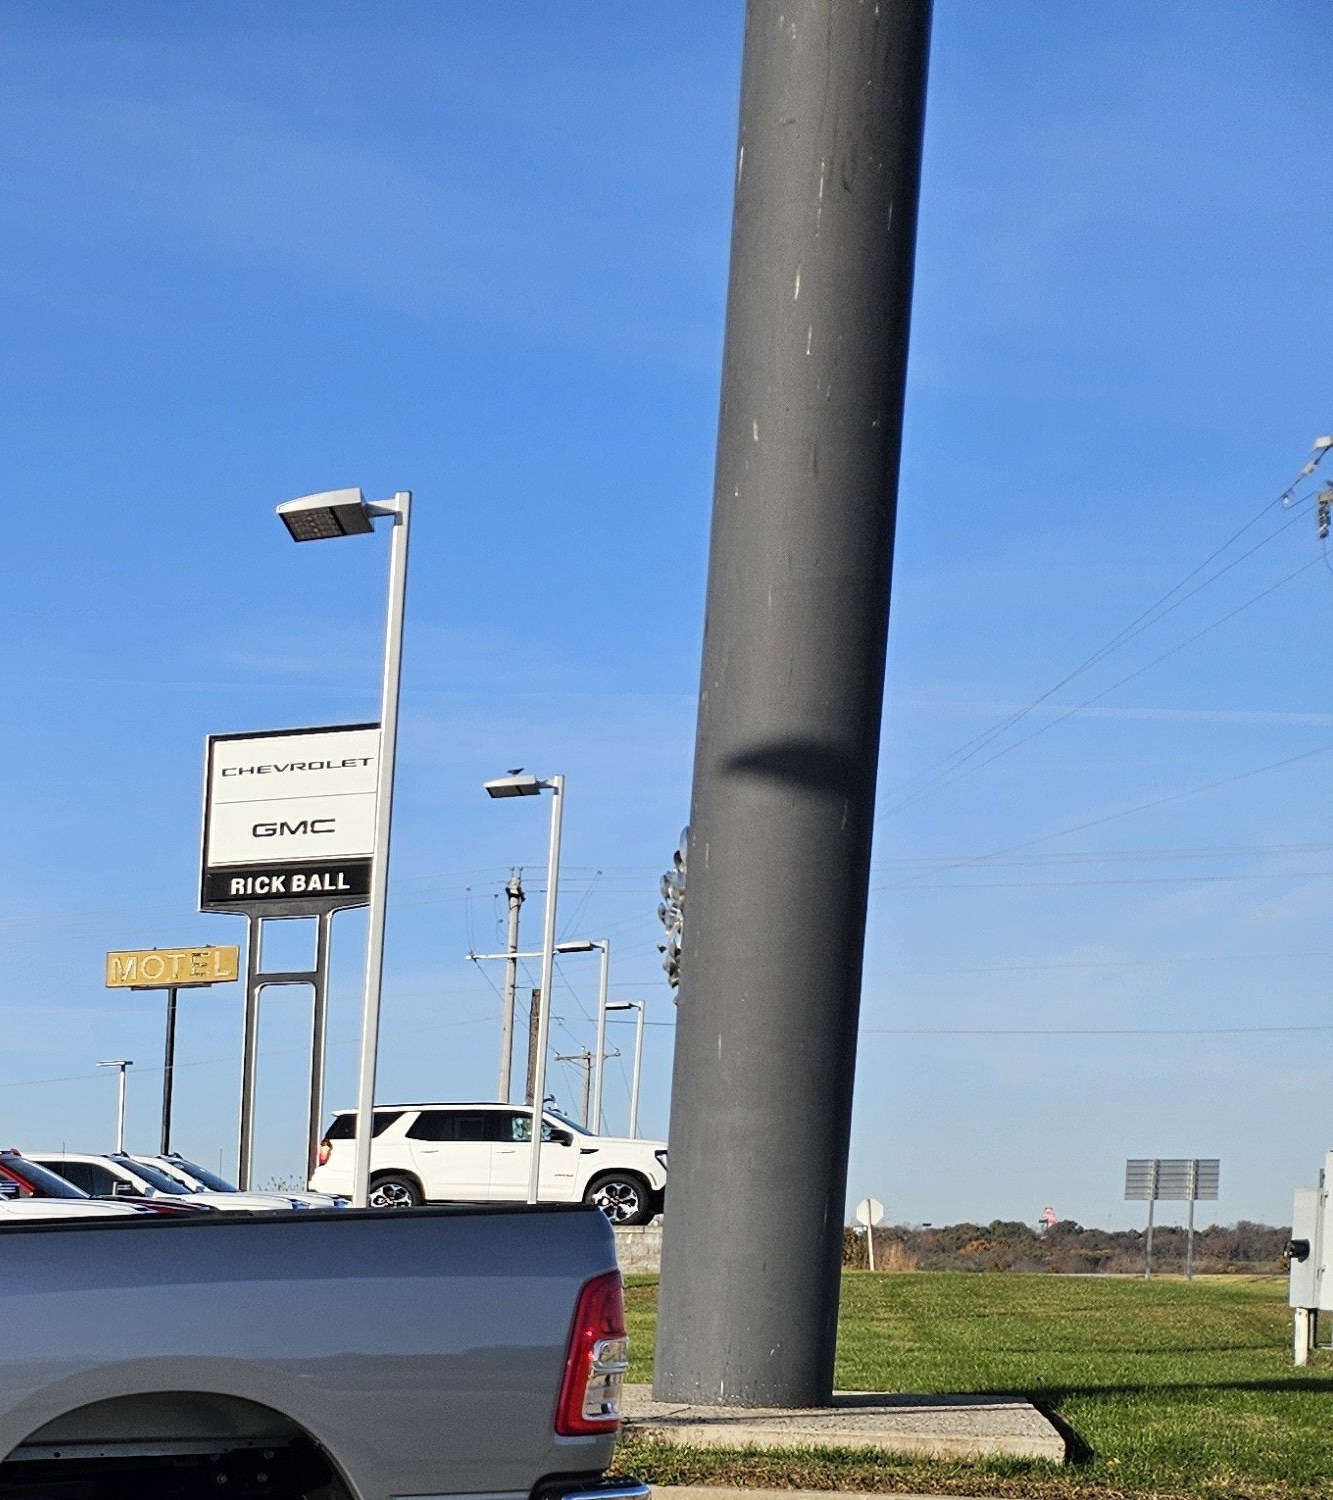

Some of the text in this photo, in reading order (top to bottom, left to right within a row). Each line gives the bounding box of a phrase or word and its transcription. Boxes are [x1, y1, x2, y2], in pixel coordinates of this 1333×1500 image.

[221, 757, 374, 777] CHEVROLET
[252, 818, 336, 838] GMC
[230, 872, 350, 895] RICK BALL
[112, 950, 233, 981] MOTEL
